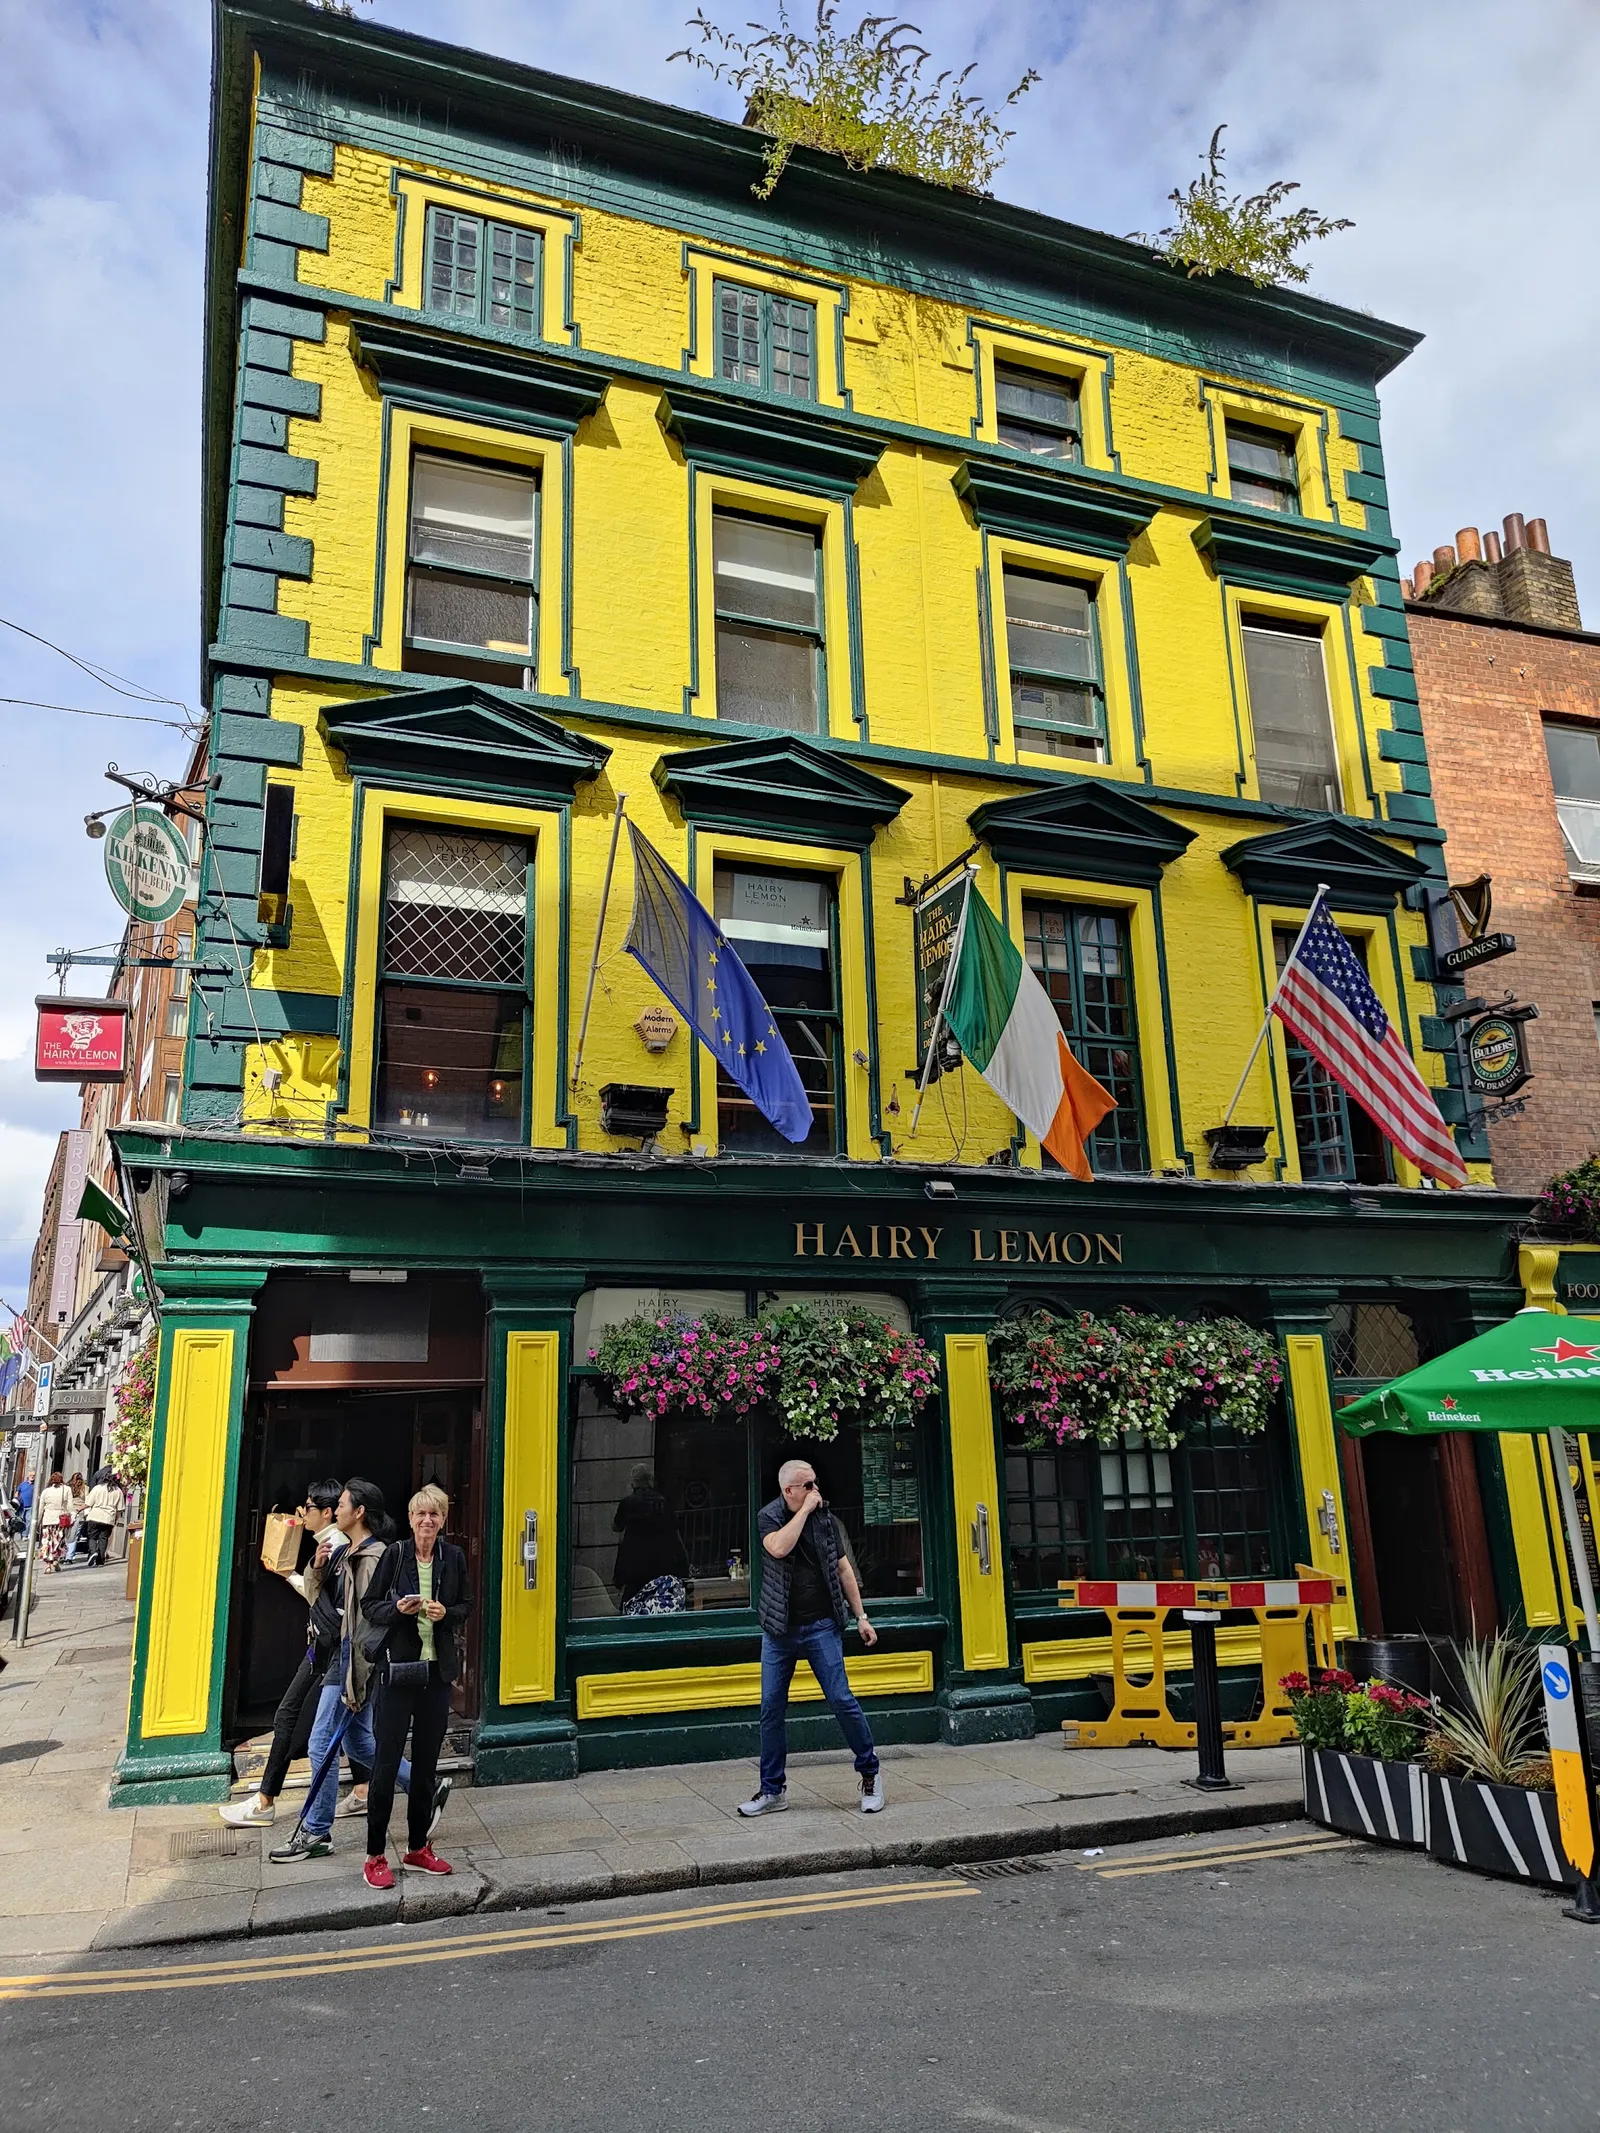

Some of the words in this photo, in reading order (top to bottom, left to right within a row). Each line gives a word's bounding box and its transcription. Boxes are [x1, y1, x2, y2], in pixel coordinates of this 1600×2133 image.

[747, 882, 784, 893] HAIRY
[745, 891, 787, 902] LEMON
[926, 904, 943, 924] THE
[790, 924, 822, 934] Heineken
[919, 911, 955, 950] HAIRY
[919, 938, 949, 971] LEMO
[1446, 937, 1499, 966] GUINNESS
[643, 1014, 674, 1023] Modern
[645, 1025, 672, 1034] Alarms
[44, 1041, 62, 1050] THE
[1473, 1040, 1514, 1059] BULMERS
[43, 1049, 77, 1059] HAIRY
[79, 1050, 117, 1060] LEMON
[1474, 1078, 1486, 1089] ON
[1486, 1065, 1522, 1090] DRAUGHT
[1477, 1066, 1501, 1078] VINTAGE
[66, 1132, 84, 1221] BROOKS
[792, 1222, 945, 1261] HAIRY
[969, 1228, 1124, 1265] LEMON
[1567, 1283, 1600, 1298] FOO
[637, 1299, 679, 1307] HAIRY
[813, 1299, 851, 1308] HAIRY
[1427, 1411, 1481, 1422] Heineken
